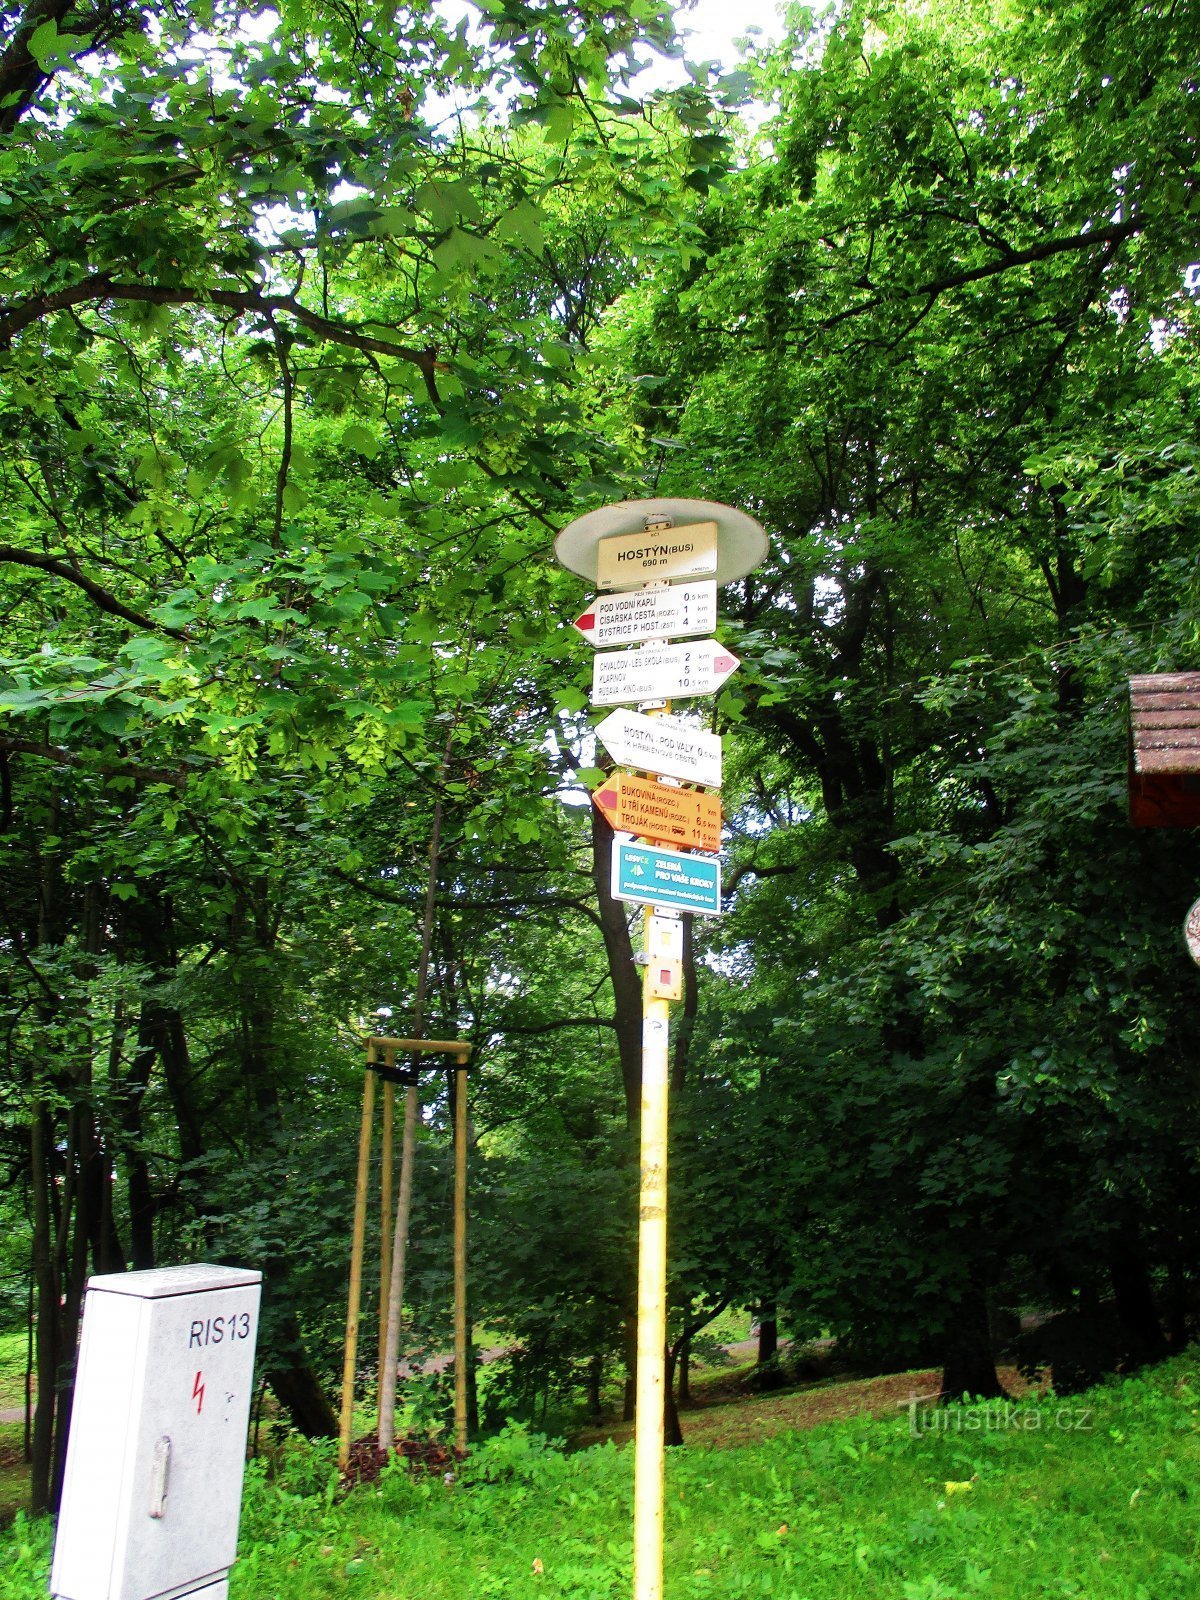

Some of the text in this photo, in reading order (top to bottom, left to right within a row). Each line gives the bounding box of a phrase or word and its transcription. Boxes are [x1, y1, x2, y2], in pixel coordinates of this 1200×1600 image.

[642, 558, 658, 568] 690
[600, 603, 614, 613] POD
[615, 598, 636, 611] VODNÍ
[636, 596, 656, 607] KAPLÍ
[600, 611, 633, 625] CÍSAŘSKÁ
[634, 610, 656, 620] CESTA
[598, 624, 632, 638] BYSTŘICE
[682, 618, 689, 626] 4
[684, 652, 691, 662] 2
[684, 665, 690, 674] 5
[624, 725, 654, 743] HOSTÝN
[660, 736, 675, 749] POD
[676, 740, 694, 753] VALY
[621, 785, 656, 801] BUKOVINA
[696, 803, 700, 813] 1
[708, 808, 717, 816] km
[621, 799, 627, 809] U
[628, 799, 639, 811] TŘÍ
[640, 803, 669, 818] KAMENŮ
[708, 822, 717, 830] km
[621, 813, 649, 828] TROJÁK
[708, 834, 717, 842] km
[655, 860, 682, 872] ZELENÁ
[654, 870, 715, 888] PRO VAŠE KROKY
